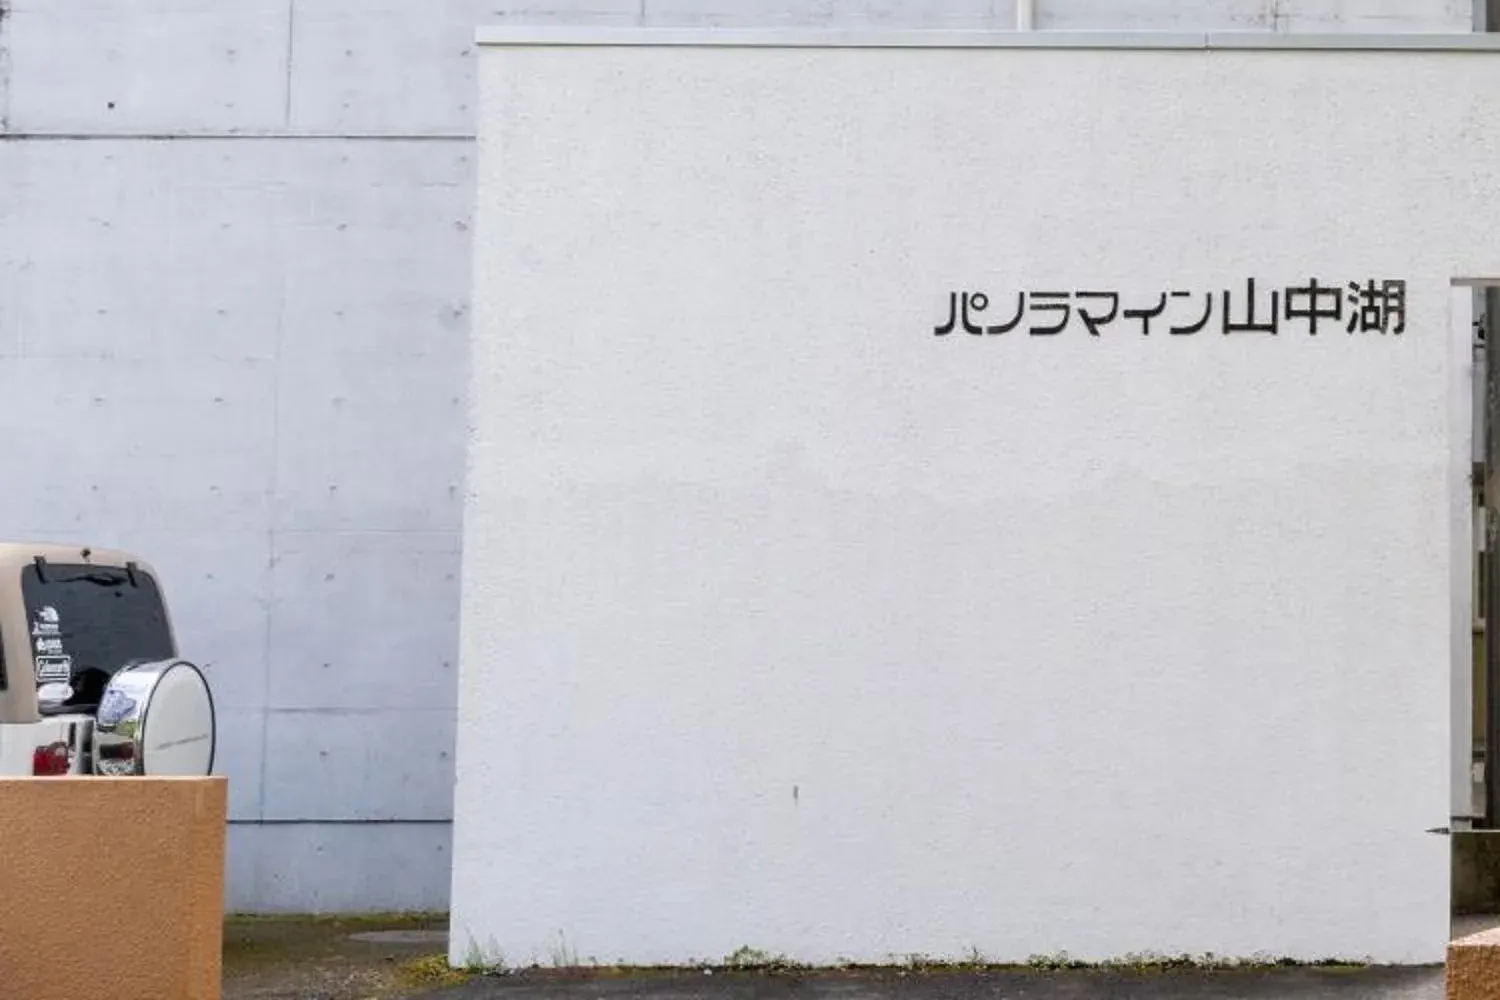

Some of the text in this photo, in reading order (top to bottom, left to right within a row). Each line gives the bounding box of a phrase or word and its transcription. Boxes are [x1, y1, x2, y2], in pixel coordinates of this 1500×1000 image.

[934, 277, 1406, 335] パノラマイン山中湖
